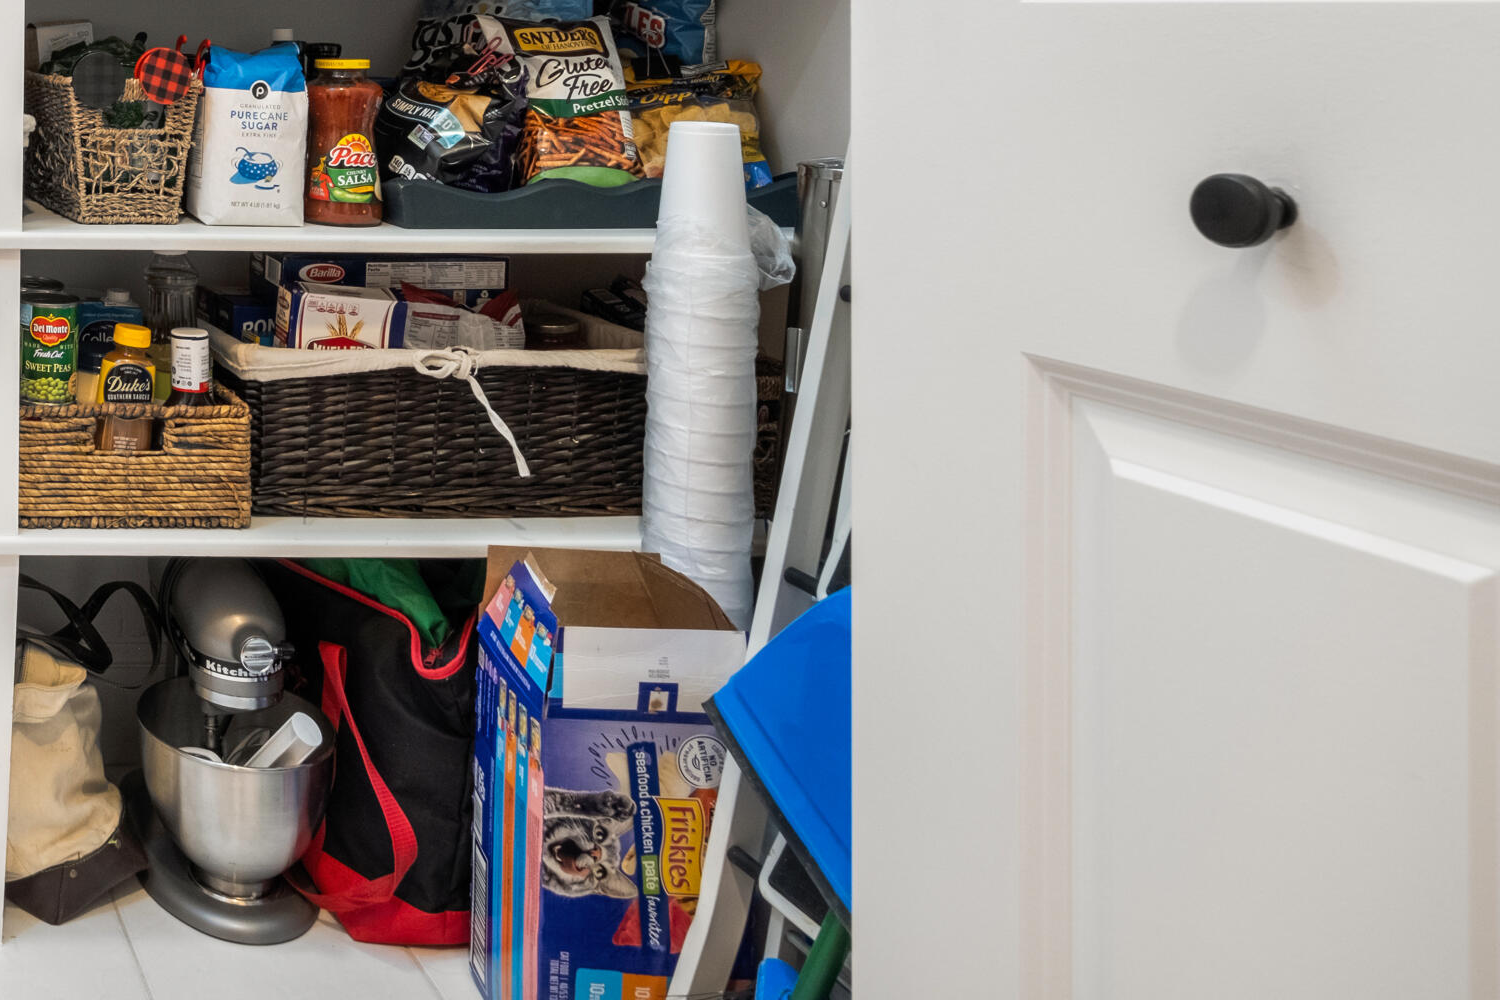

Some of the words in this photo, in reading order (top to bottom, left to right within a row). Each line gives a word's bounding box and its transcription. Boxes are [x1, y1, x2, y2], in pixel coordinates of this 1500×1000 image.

[562, 73, 613, 104] Free
[573, 95, 616, 114] Pretzel
[391, 98, 422, 117] SIMPLY
[418, 106, 454, 130] NAKD
[241, 121, 278, 131] SUGAR
[337, 173, 374, 186] SALSA
[309, 267, 342, 278] Barilla
[33, 323, 45, 333] Del
[45, 324, 68, 334] Monte
[82, 332, 114, 343] Colle
[25, 360, 52, 373] SWEET
[53, 363, 72, 373] PEAS
[107, 375, 151, 393] Duke's
[205, 659, 282, 677] KitchAid
[697, 740, 713, 783] ARTIFICIAL
[708, 754, 717, 767] NO
[636, 750, 651, 799] seafood
[641, 807, 655, 854] chicken
[668, 805, 697, 891] Friskies
[647, 894, 663, 947] favorites
[589, 983, 605, 995] 10
[635, 986, 651, 998] 10
